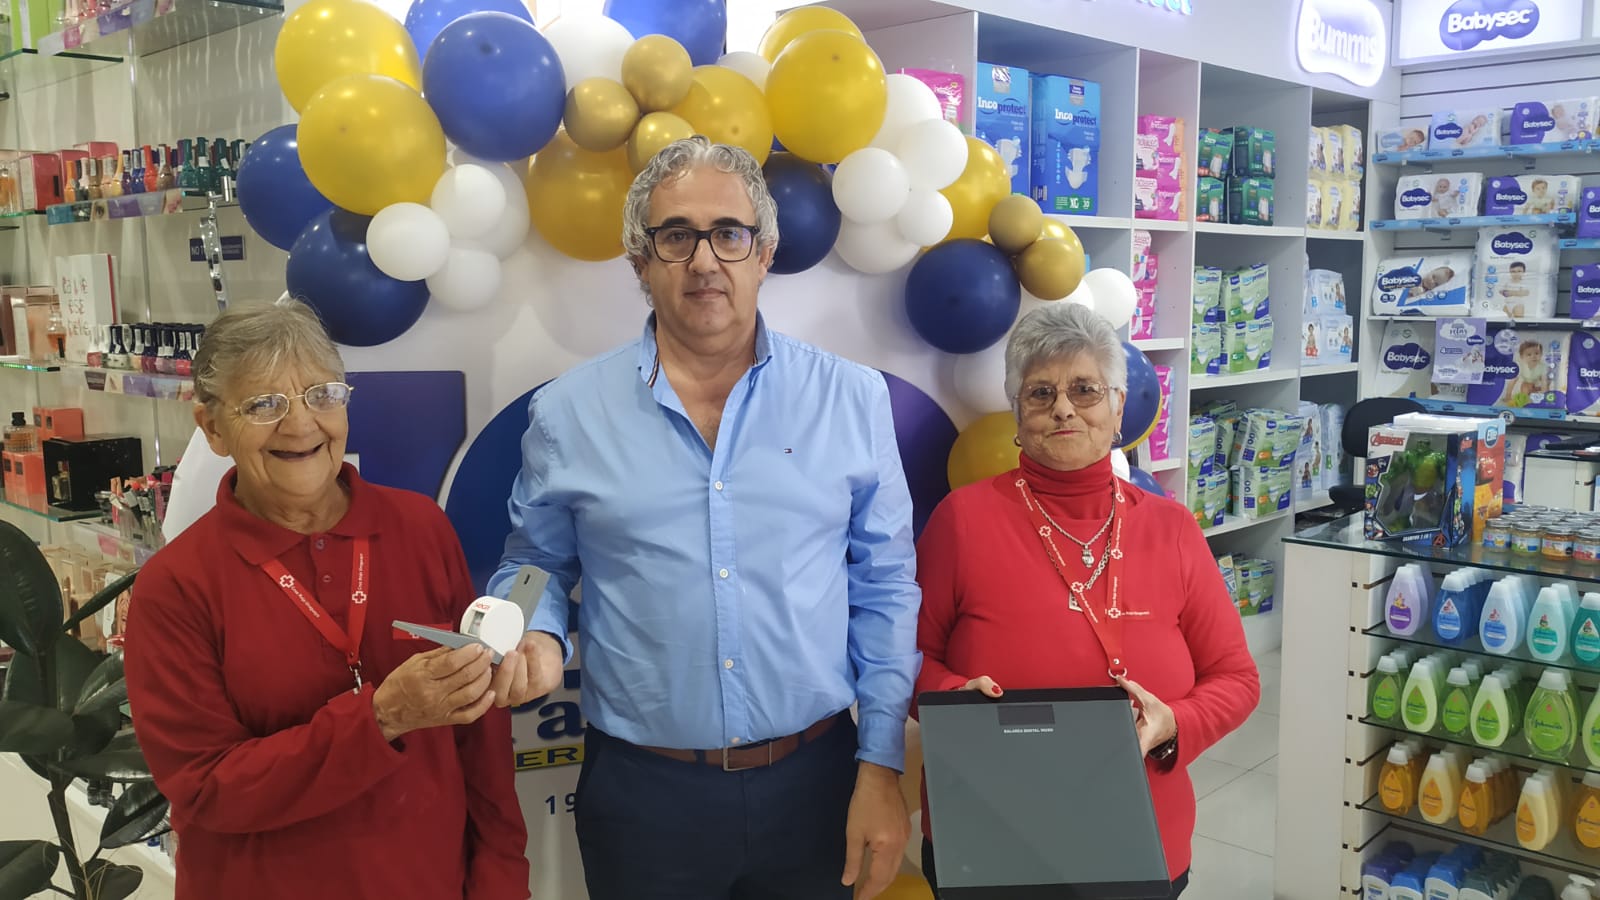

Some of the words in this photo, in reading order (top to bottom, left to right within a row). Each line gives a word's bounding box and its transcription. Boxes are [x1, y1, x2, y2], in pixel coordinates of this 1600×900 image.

[1447, 8, 1532, 33] Babysec
[977, 96, 1026, 115] Incoprotect
[1055, 108, 1097, 126] Incoprotect
[1523, 119, 1552, 129] Babysec
[1401, 194, 1430, 203] Babysec
[1496, 193, 1525, 202] Babysec
[1494, 240, 1530, 250] Babysec
[1381, 276, 1418, 286] Babysec
[1386, 351, 1427, 363] Babysec
[1483, 365, 1516, 374] abysec
